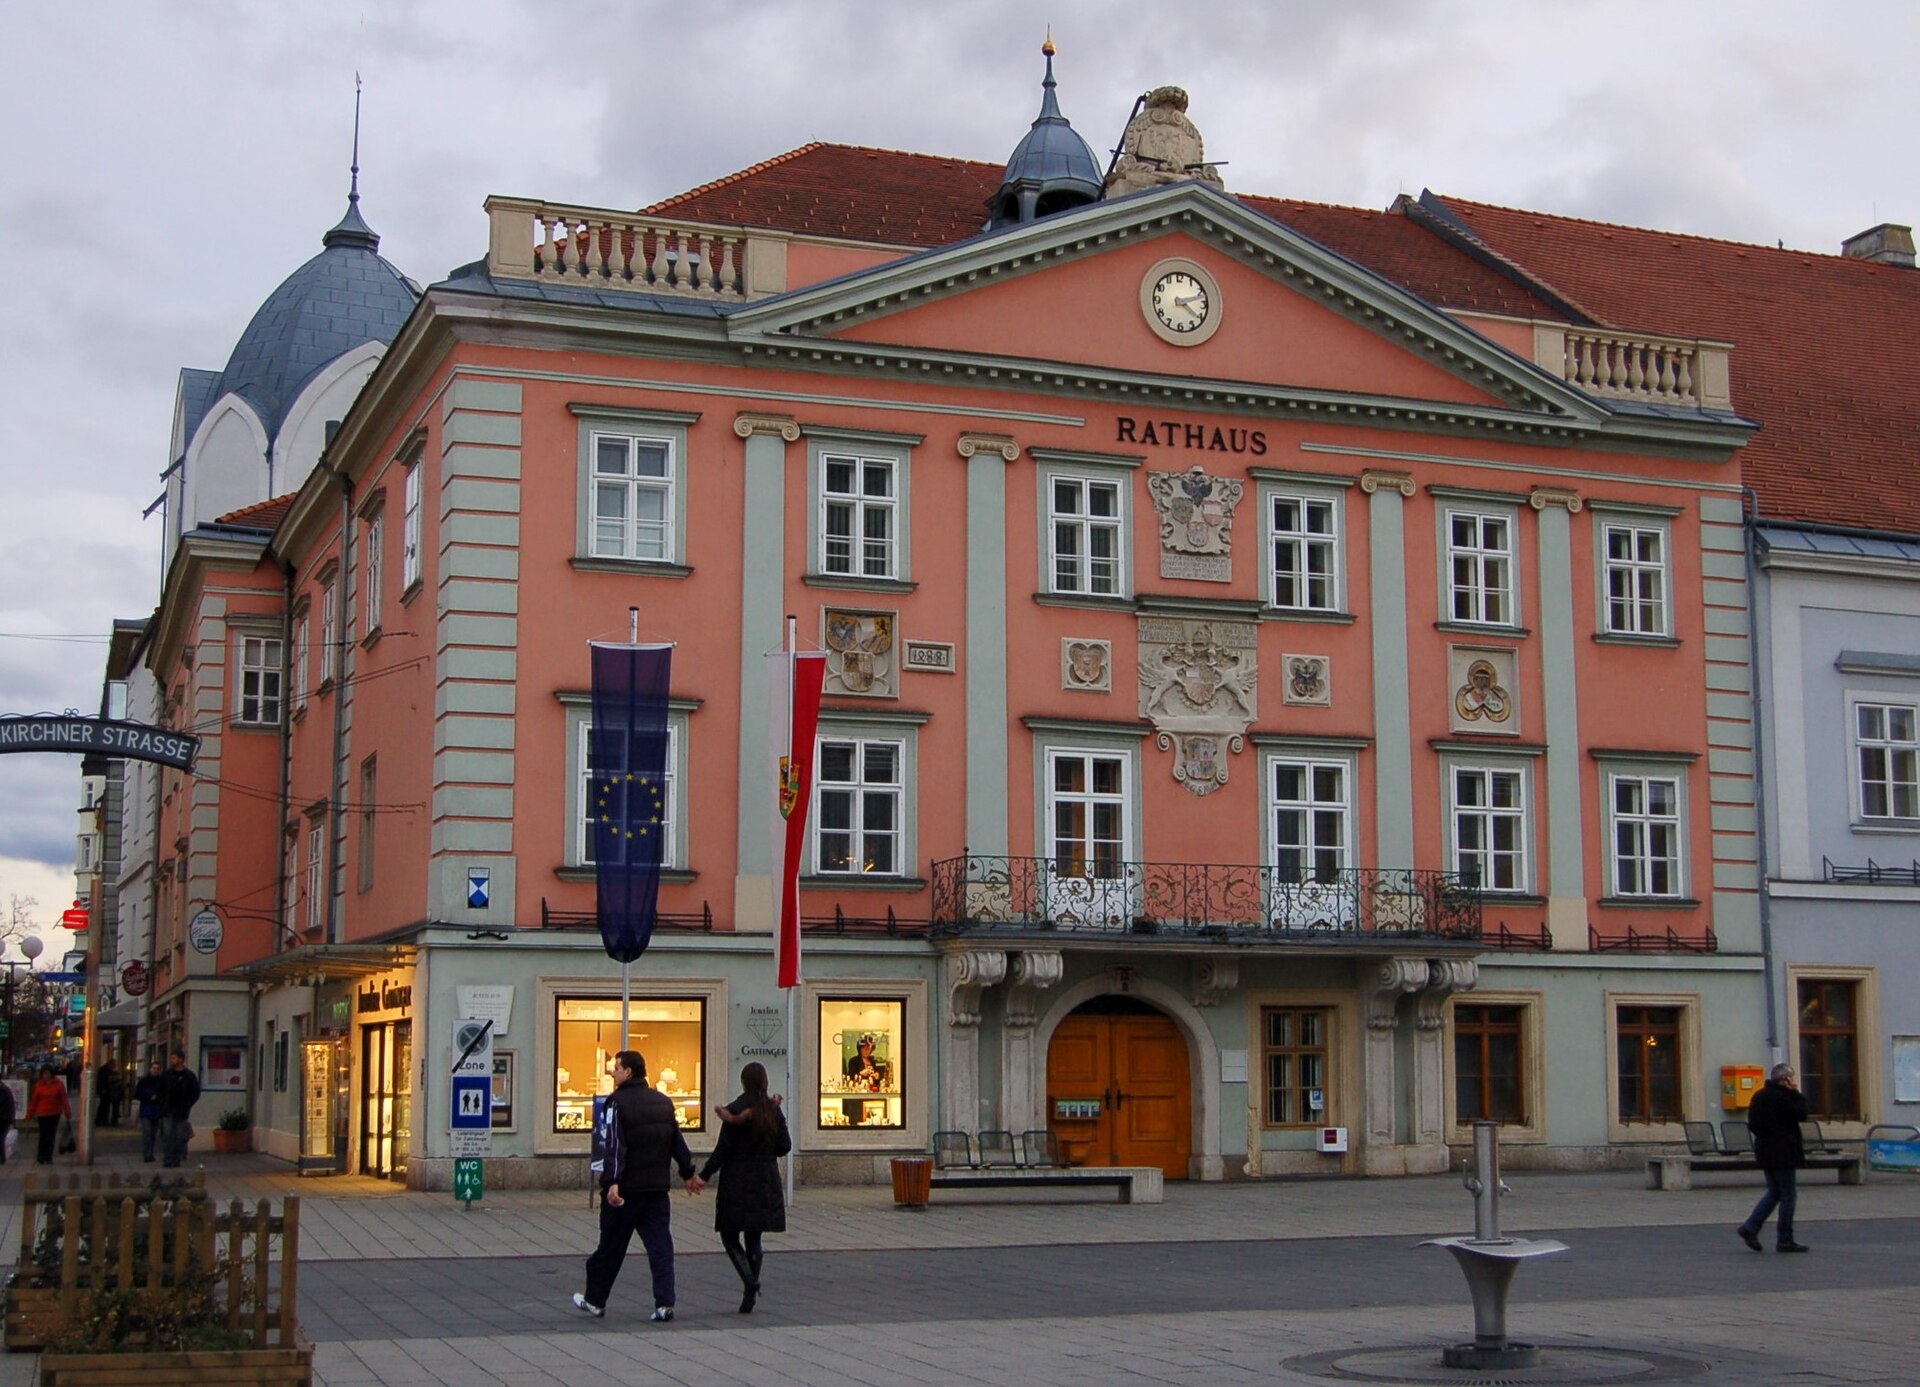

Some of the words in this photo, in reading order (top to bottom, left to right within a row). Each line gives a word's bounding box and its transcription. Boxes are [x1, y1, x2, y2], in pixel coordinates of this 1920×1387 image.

[1176, 274, 1184, 283] 12
[1153, 296, 1161, 304] 9
[1200, 301, 1207, 310] 3
[1158, 308, 1164, 317] 8
[1166, 318, 1172, 327] 7
[1177, 322, 1184, 331] 6
[1116, 416, 1268, 456] RATHAUS
[0, 723, 94, 744] KIRCHNER
[102, 726, 191, 761] STRASSE
[460, 1161, 478, 1170] WC
